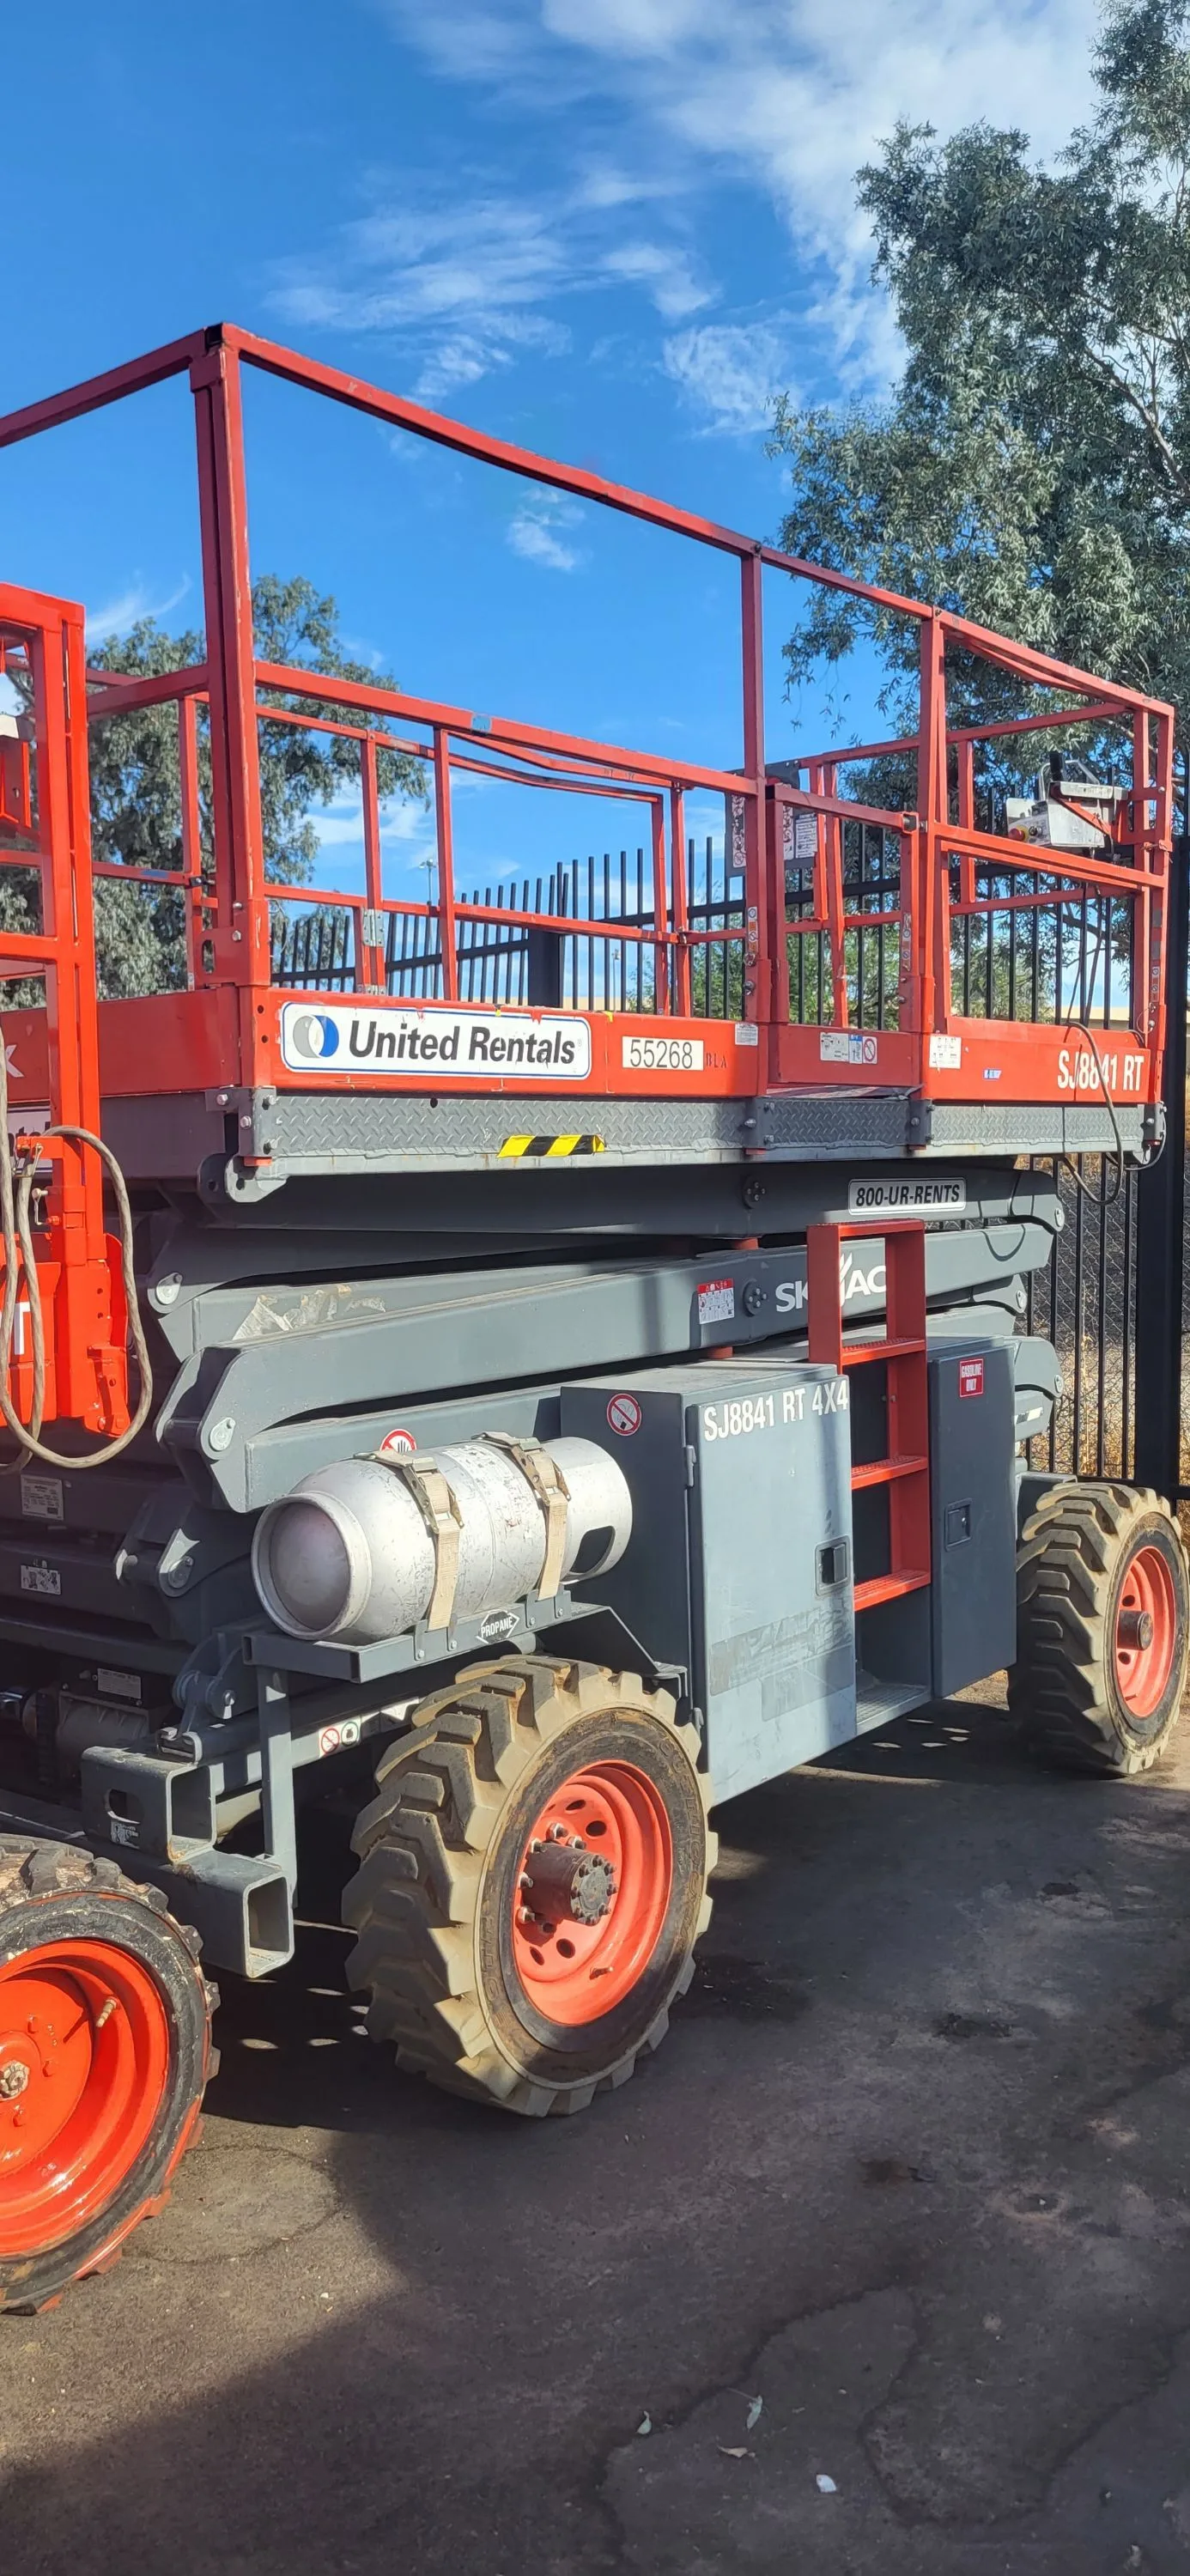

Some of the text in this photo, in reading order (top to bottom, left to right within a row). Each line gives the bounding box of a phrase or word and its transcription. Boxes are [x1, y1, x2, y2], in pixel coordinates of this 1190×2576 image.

[349, 1020, 574, 1065] United Rentals
[629, 1039, 693, 1069] 55268
[1057, 1049, 1144, 1091] SJ8841 RT
[856, 1184, 960, 1207] 800-UR-RENTS
[704, 1380, 848, 1442] SJ8841 RT 4X4
[481, 1616, 513, 1638] PROPANE
